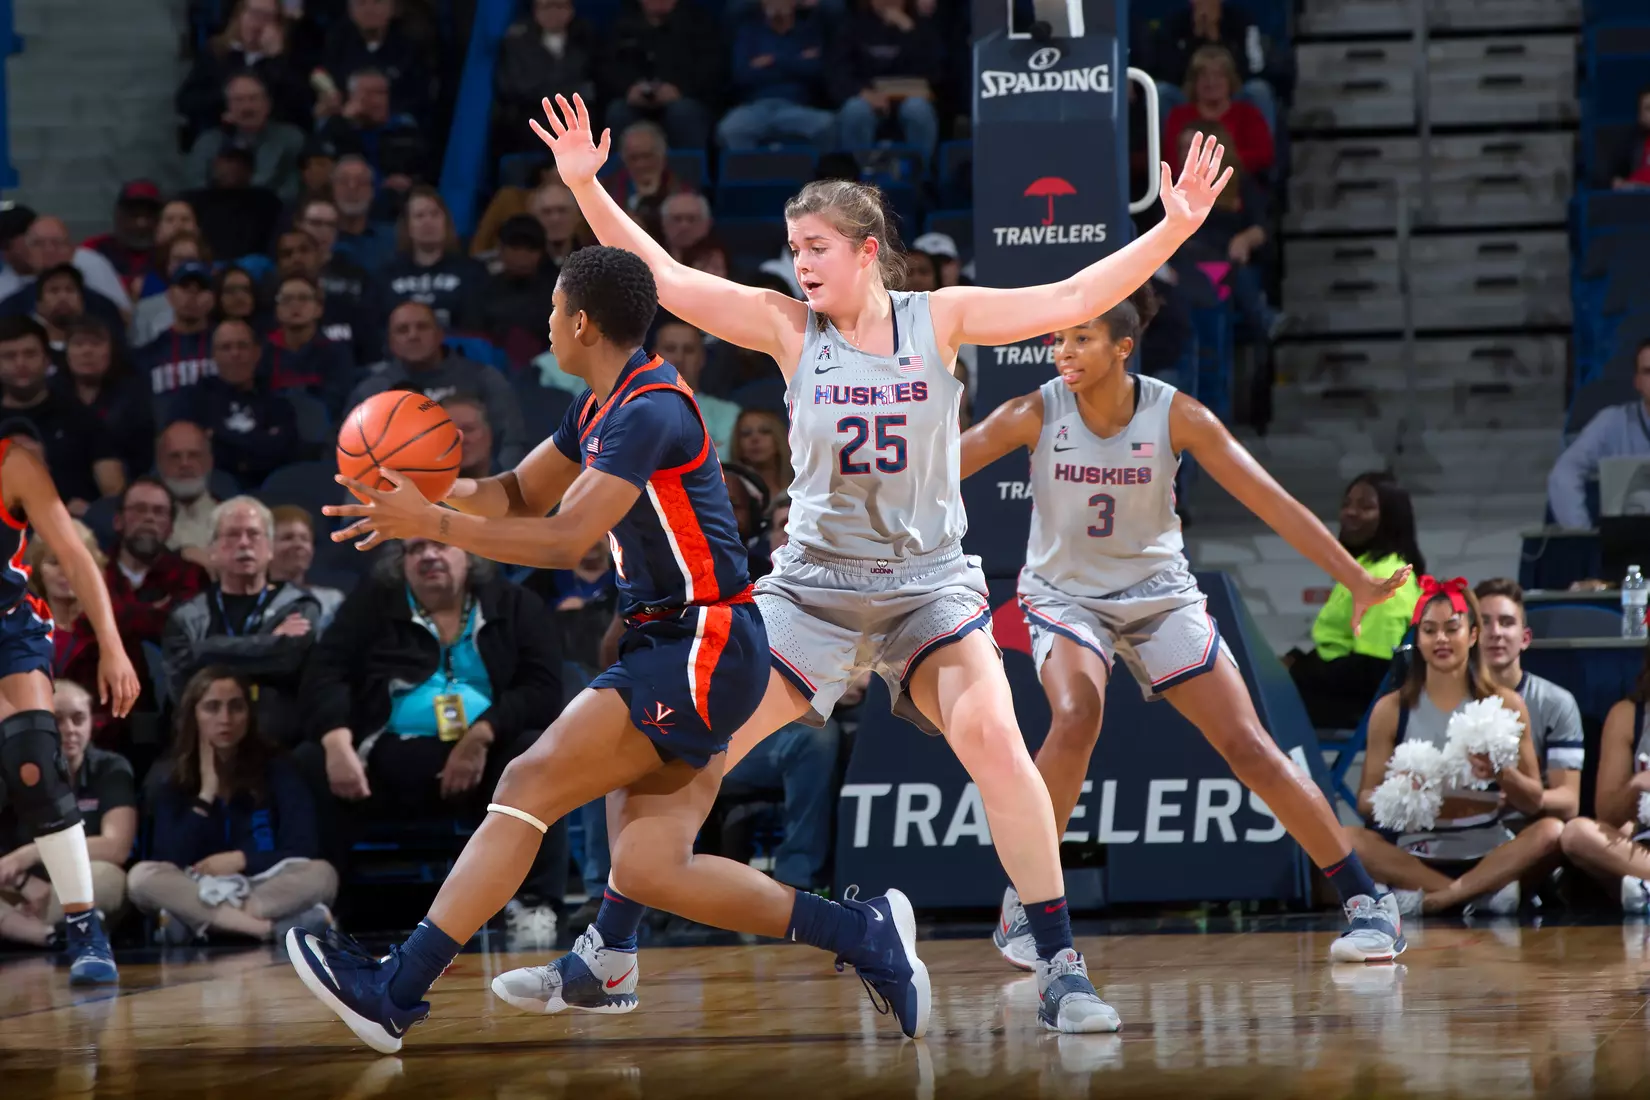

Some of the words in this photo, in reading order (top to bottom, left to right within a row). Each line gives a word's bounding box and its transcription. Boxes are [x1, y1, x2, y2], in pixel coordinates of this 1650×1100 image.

[981, 64, 1111, 98] SPALDING
[993, 224, 1106, 246] TRAVELERS
[993, 346, 1055, 365] TRAVE
[814, 381, 928, 405] HUSKIES
[836, 415, 908, 475] 25
[1054, 463, 1152, 485] HUSKIES
[1087, 493, 1116, 538] 3
[840, 779, 1288, 848] TRALERS
